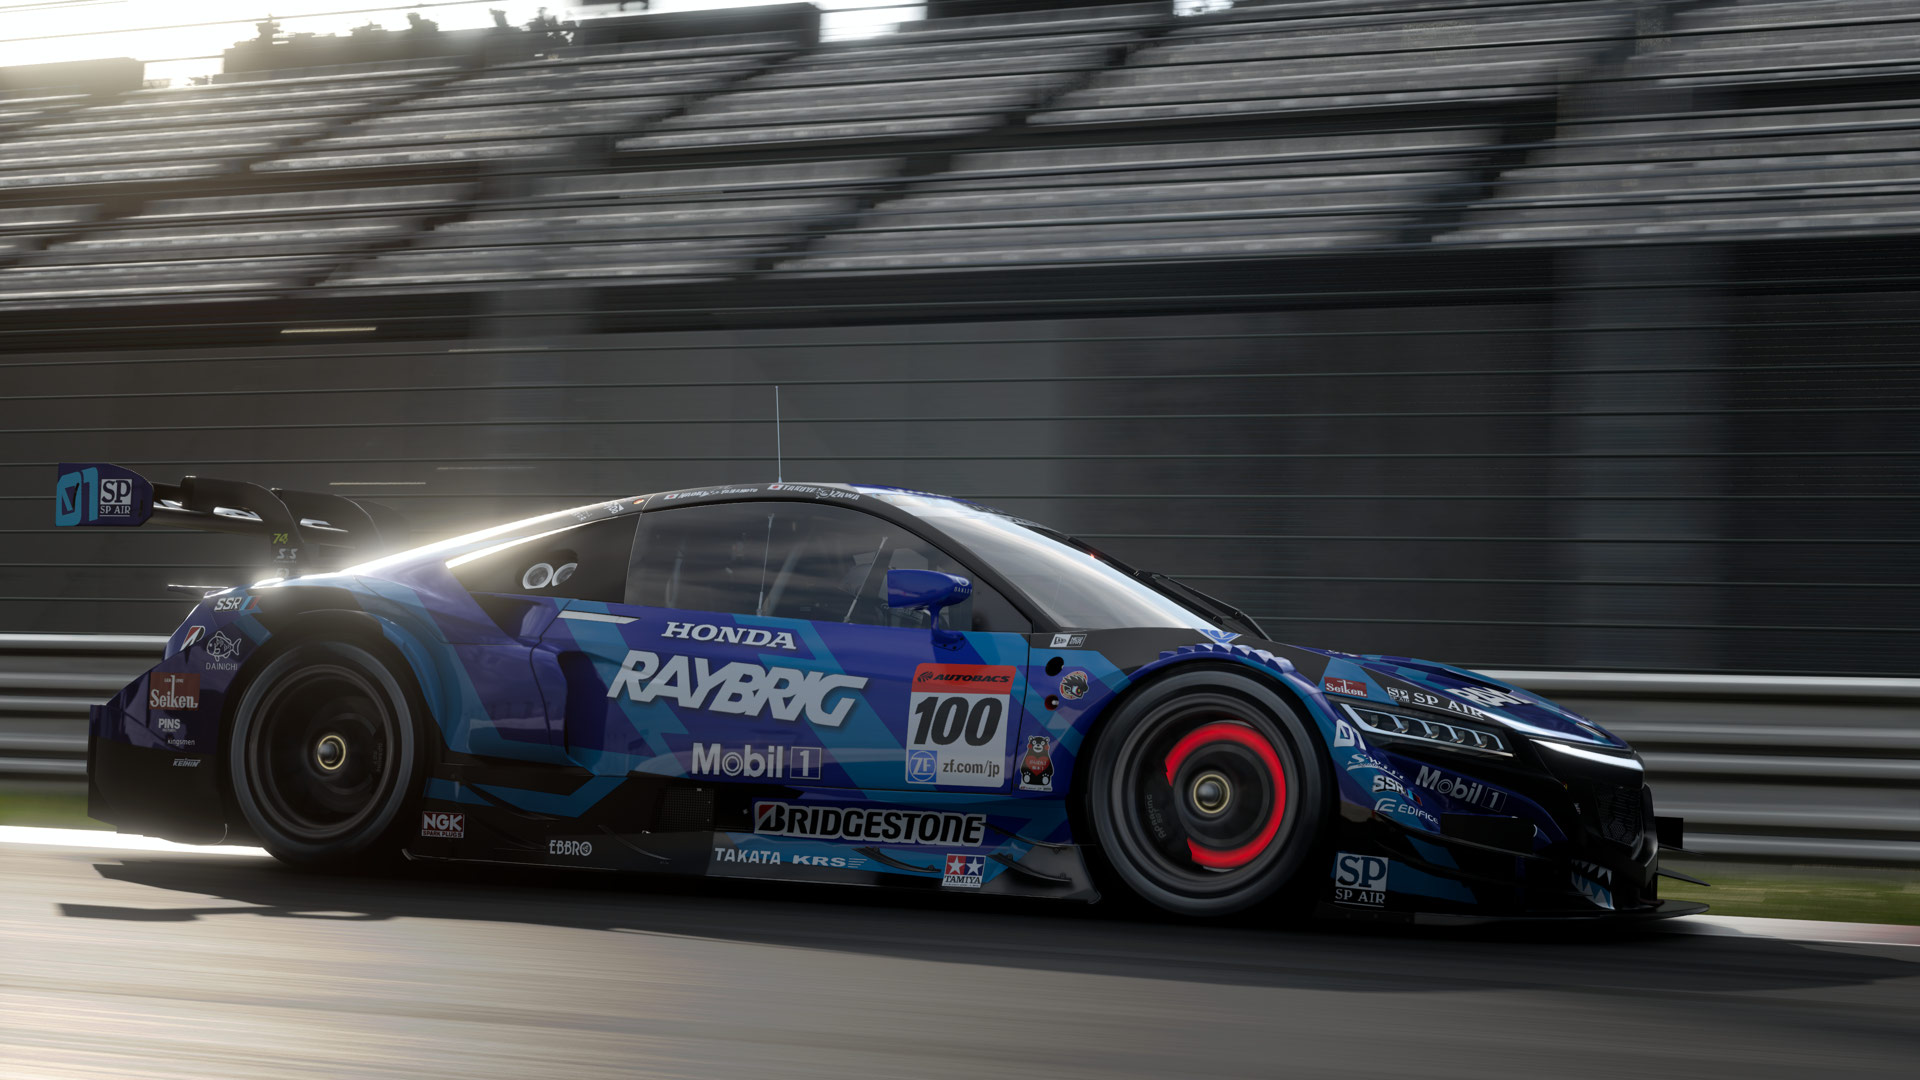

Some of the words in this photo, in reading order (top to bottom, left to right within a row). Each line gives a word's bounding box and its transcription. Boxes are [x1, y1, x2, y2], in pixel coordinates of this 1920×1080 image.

[101, 480, 131, 503] SP
[100, 506, 111, 514] SP
[114, 506, 131, 514] AIR
[214, 597, 242, 612] SSR
[661, 621, 797, 650] HONDA
[206, 662, 238, 671] DAINICHI
[606, 649, 869, 727] RAYBRIG
[933, 674, 1011, 683] AUTOBACS
[1414, 692, 1438, 705] SP
[1448, 700, 1484, 718] AIR
[158, 718, 181, 729] PINS
[914, 696, 1002, 746] 100
[173, 758, 201, 767] KEIHIN
[691, 742, 783, 779] Mobil
[799, 750, 810, 777] 1
[943, 759, 1000, 777] zf.com/jp
[1372, 775, 1408, 797] SSR
[1415, 765, 1482, 804] Mobil
[1490, 792, 1499, 808] 1
[423, 813, 464, 832] NGK
[758, 804, 984, 844] BRIDGESTONE
[1398, 804, 1439, 825] EDIFICE
[549, 840, 592, 856] EBBRO
[715, 847, 781, 865] TAKATA
[792, 855, 846, 868] KRS
[945, 875, 981, 884] TAMIYA
[1338, 855, 1386, 888] SP
[1335, 889, 1353, 901] SP
[1358, 891, 1386, 904] AIR
